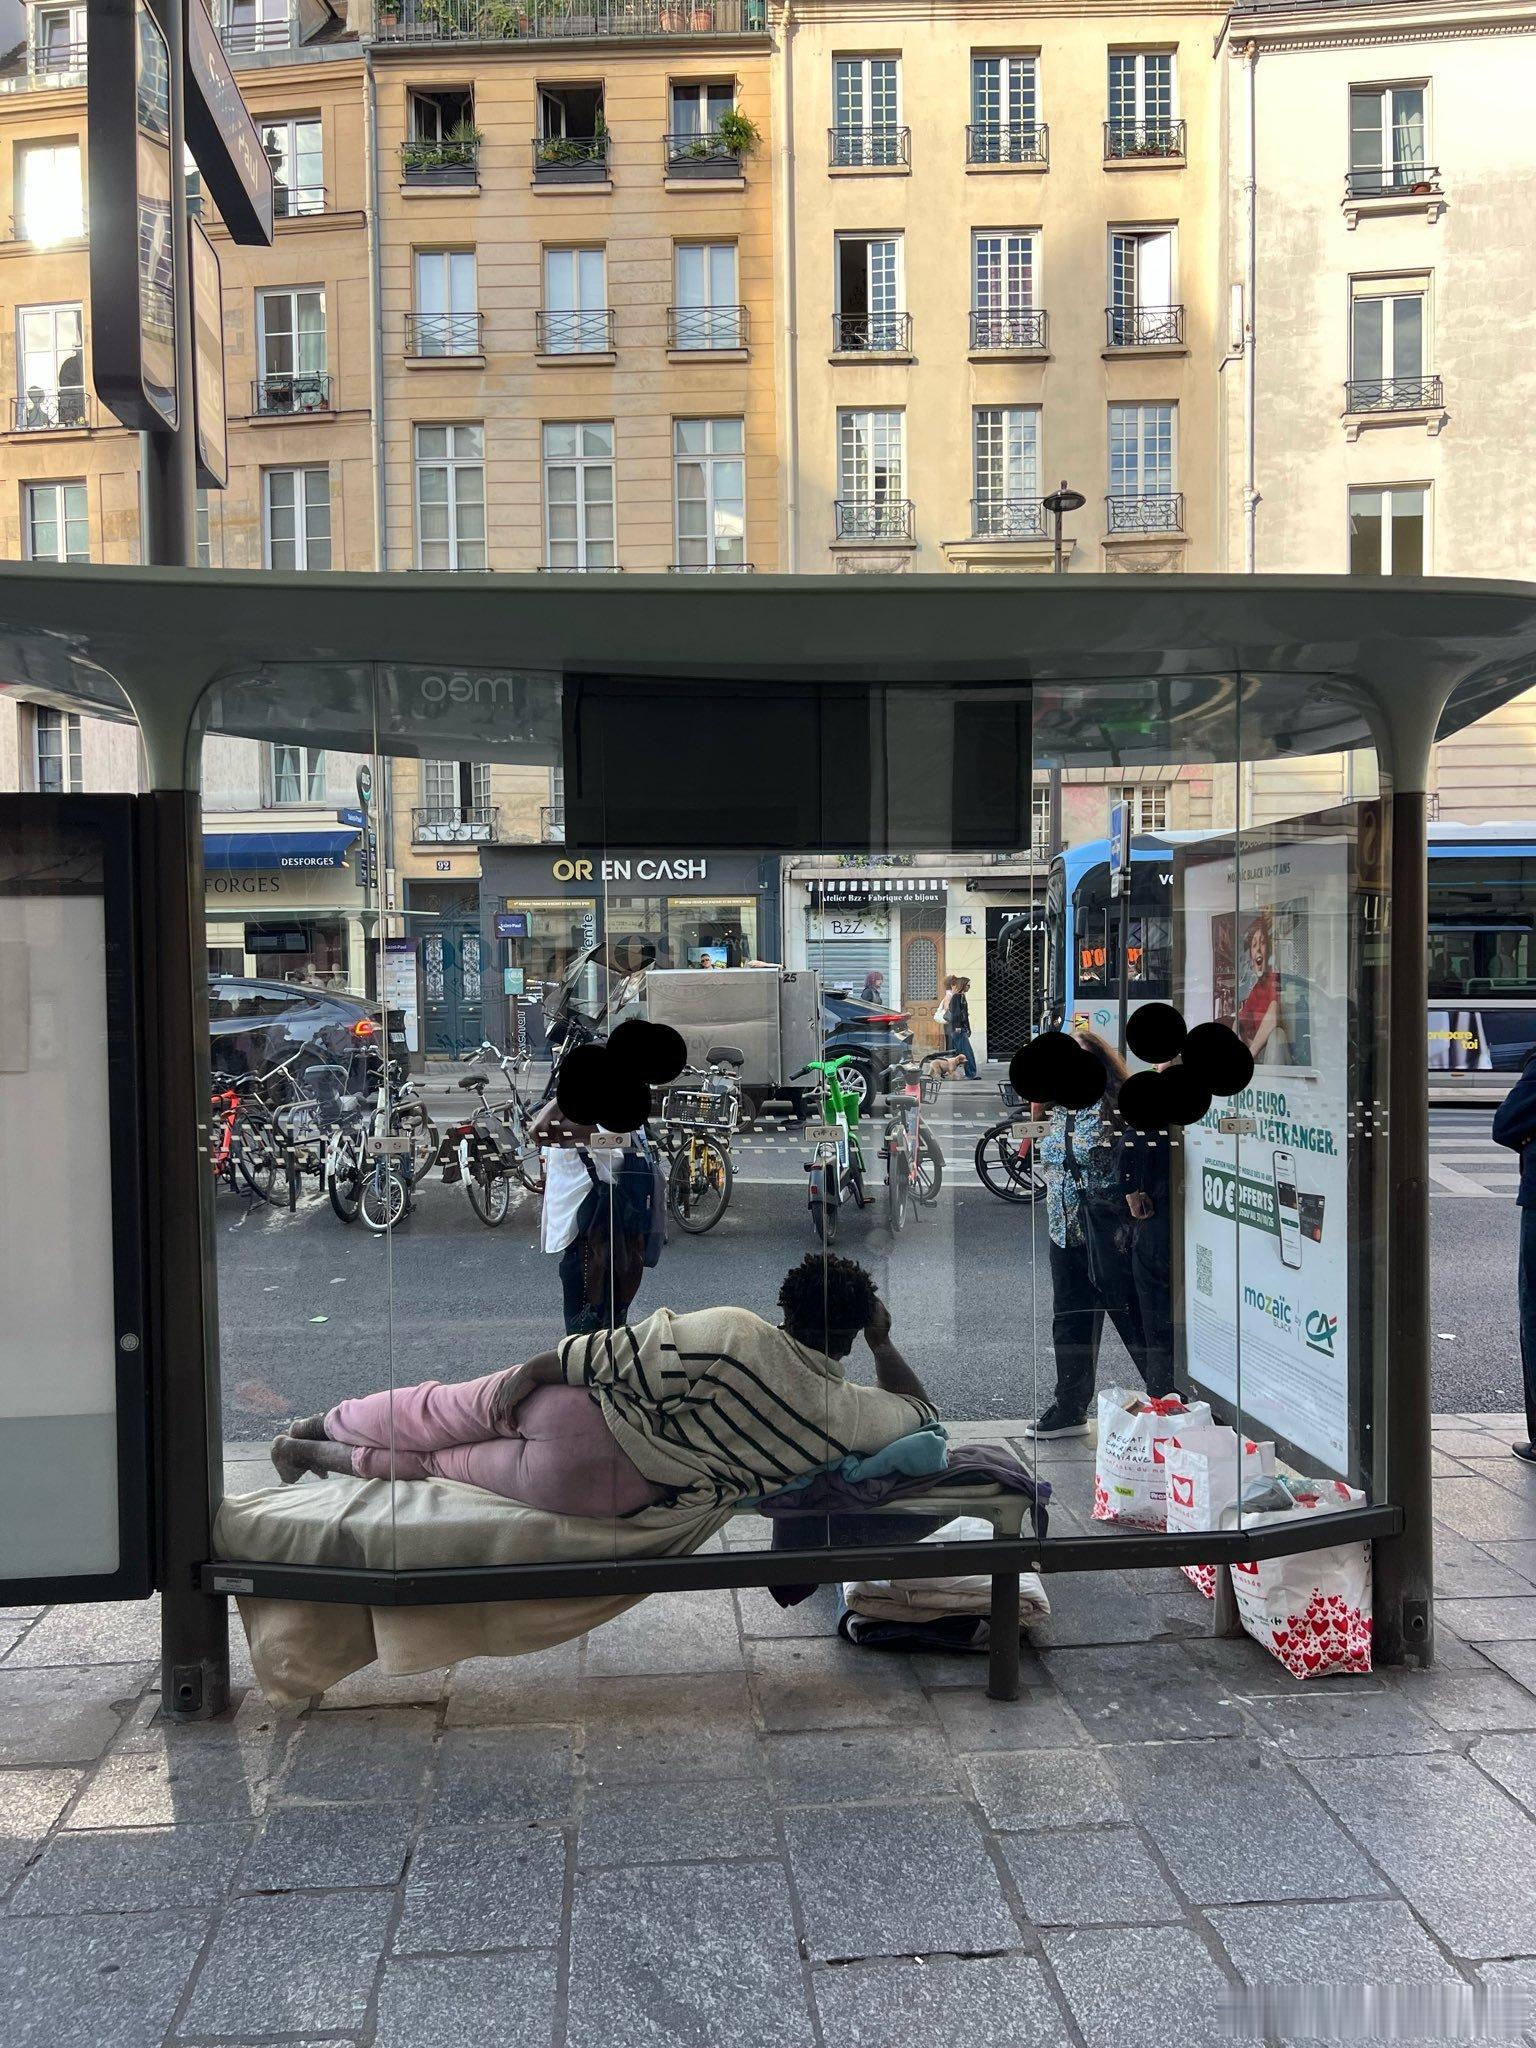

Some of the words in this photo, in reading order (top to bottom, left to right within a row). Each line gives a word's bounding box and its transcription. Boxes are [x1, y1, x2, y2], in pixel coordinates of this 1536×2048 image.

[281, 857, 334, 866] DESFORGES
[437, 861, 450, 870] 92
[552, 859, 593, 881] OR
[601, 860, 631, 880] EN
[636, 859, 707, 880] CASH
[205, 877, 280, 893] FORGES
[868, 894, 903, 903] Fabrique
[915, 894, 939, 903] bijoux
[783, 974, 797, 983] 25
[1461, 1039, 1478, 1050] toi
[1256, 1091, 1291, 1118] EURO.
[1204, 1174, 1224, 1209] 80
[1225, 1180, 1236, 1214] €
[1244, 1285, 1292, 1324] mozaïc
[1273, 1320, 1293, 1335] BLACK
